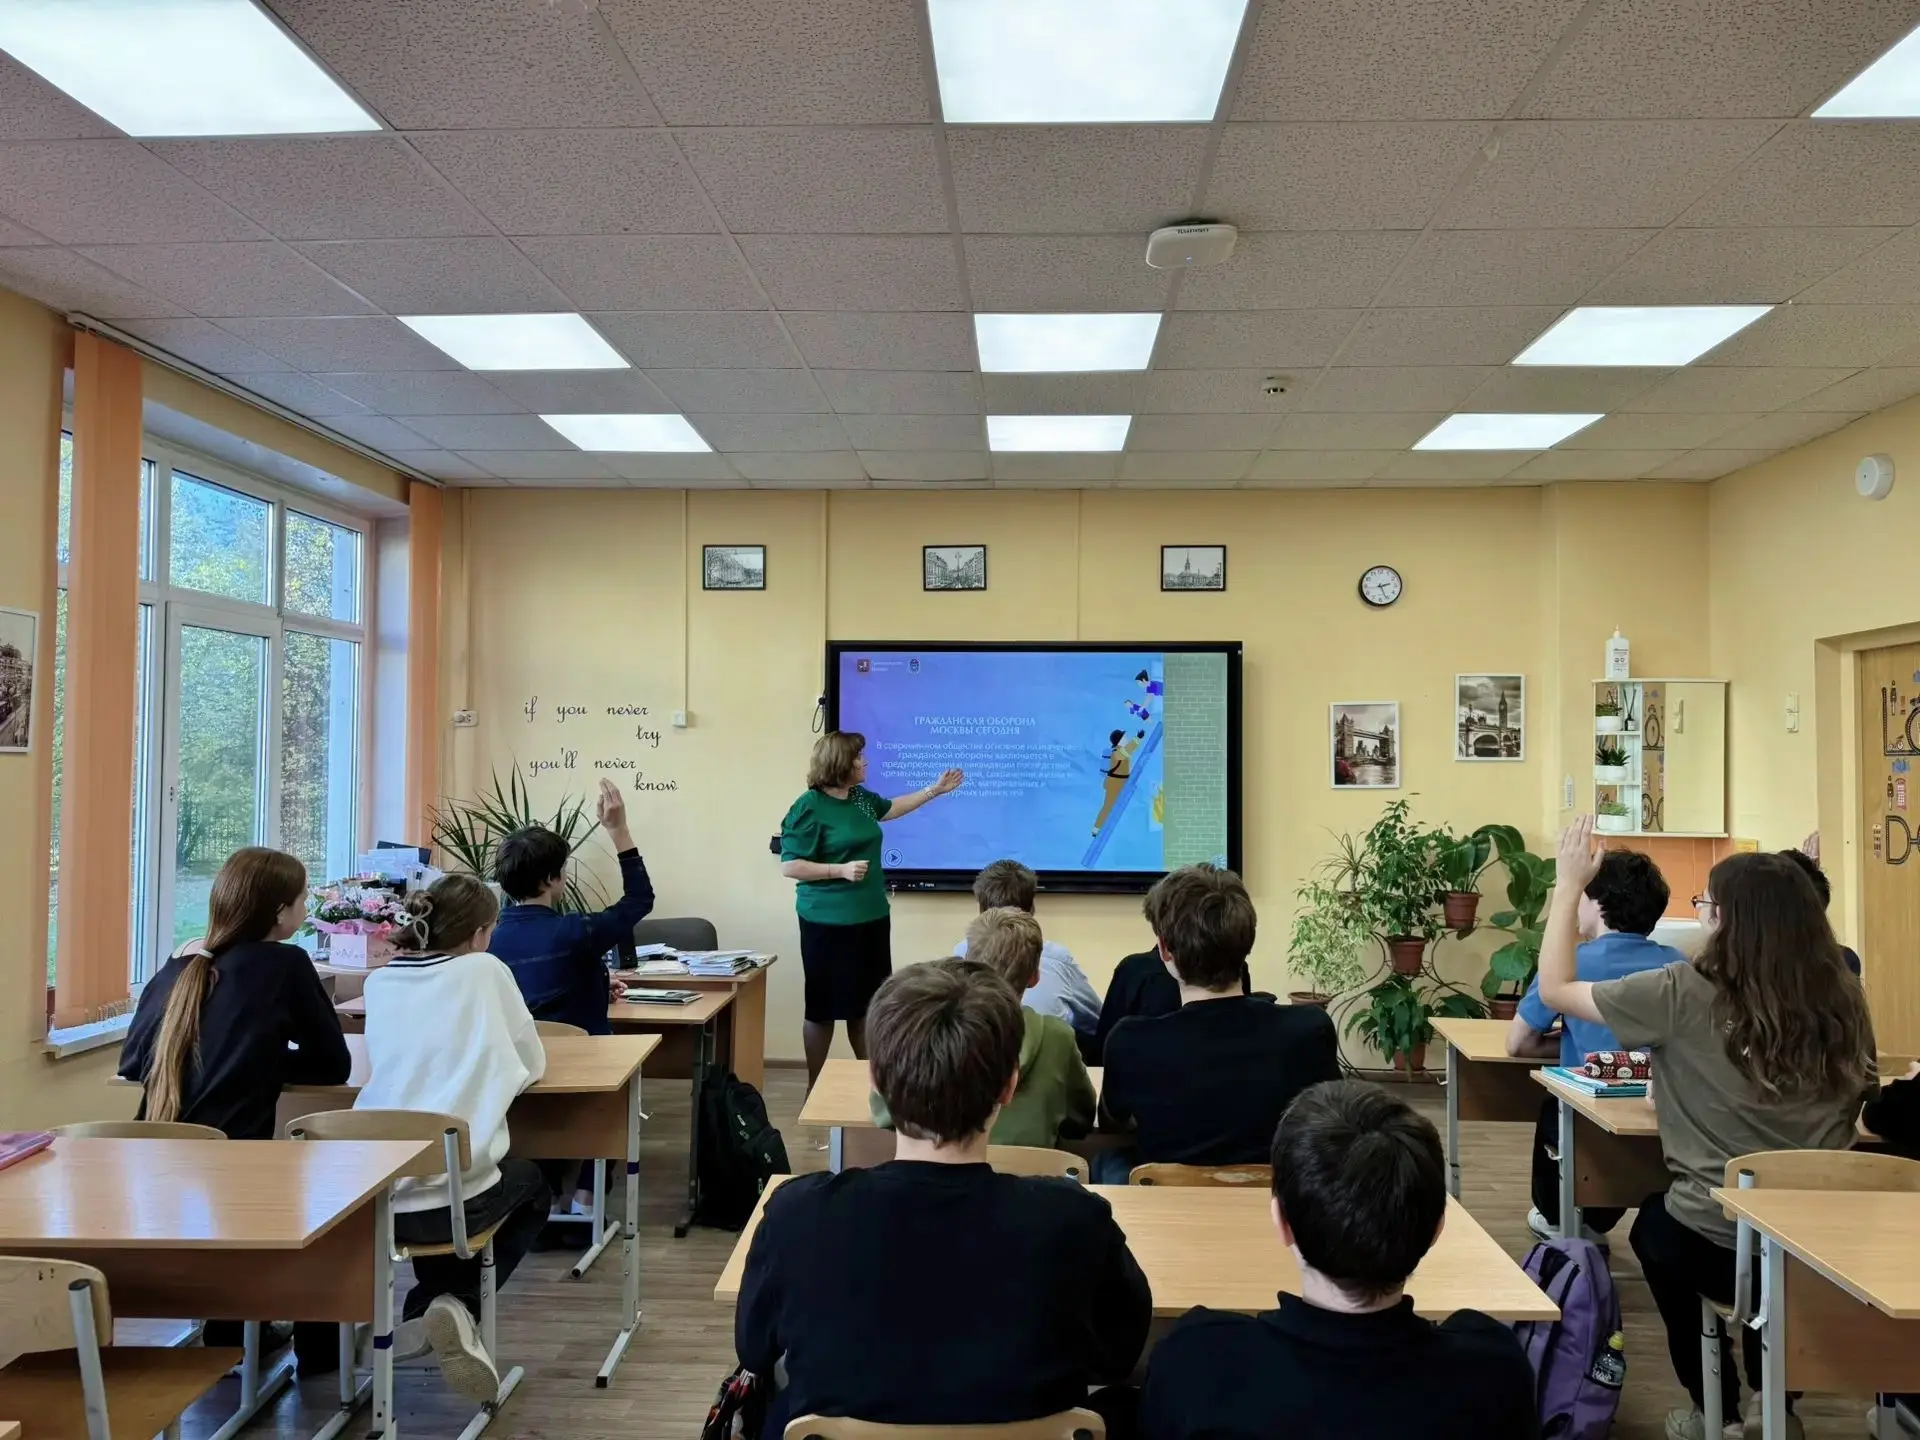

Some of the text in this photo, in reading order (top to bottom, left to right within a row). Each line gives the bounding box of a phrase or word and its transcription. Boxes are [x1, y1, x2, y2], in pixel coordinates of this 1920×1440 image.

[524, 695, 650, 723] if you never
[914, 716, 1036, 726] ГРАЖДАНСКАЯ ОБОРОНА
[930, 726, 1020, 735] МОСКВЫ СЕГОДНЯ
[635, 724, 661, 748] try
[528, 747, 636, 778] you'll never
[633, 772, 678, 791] know
